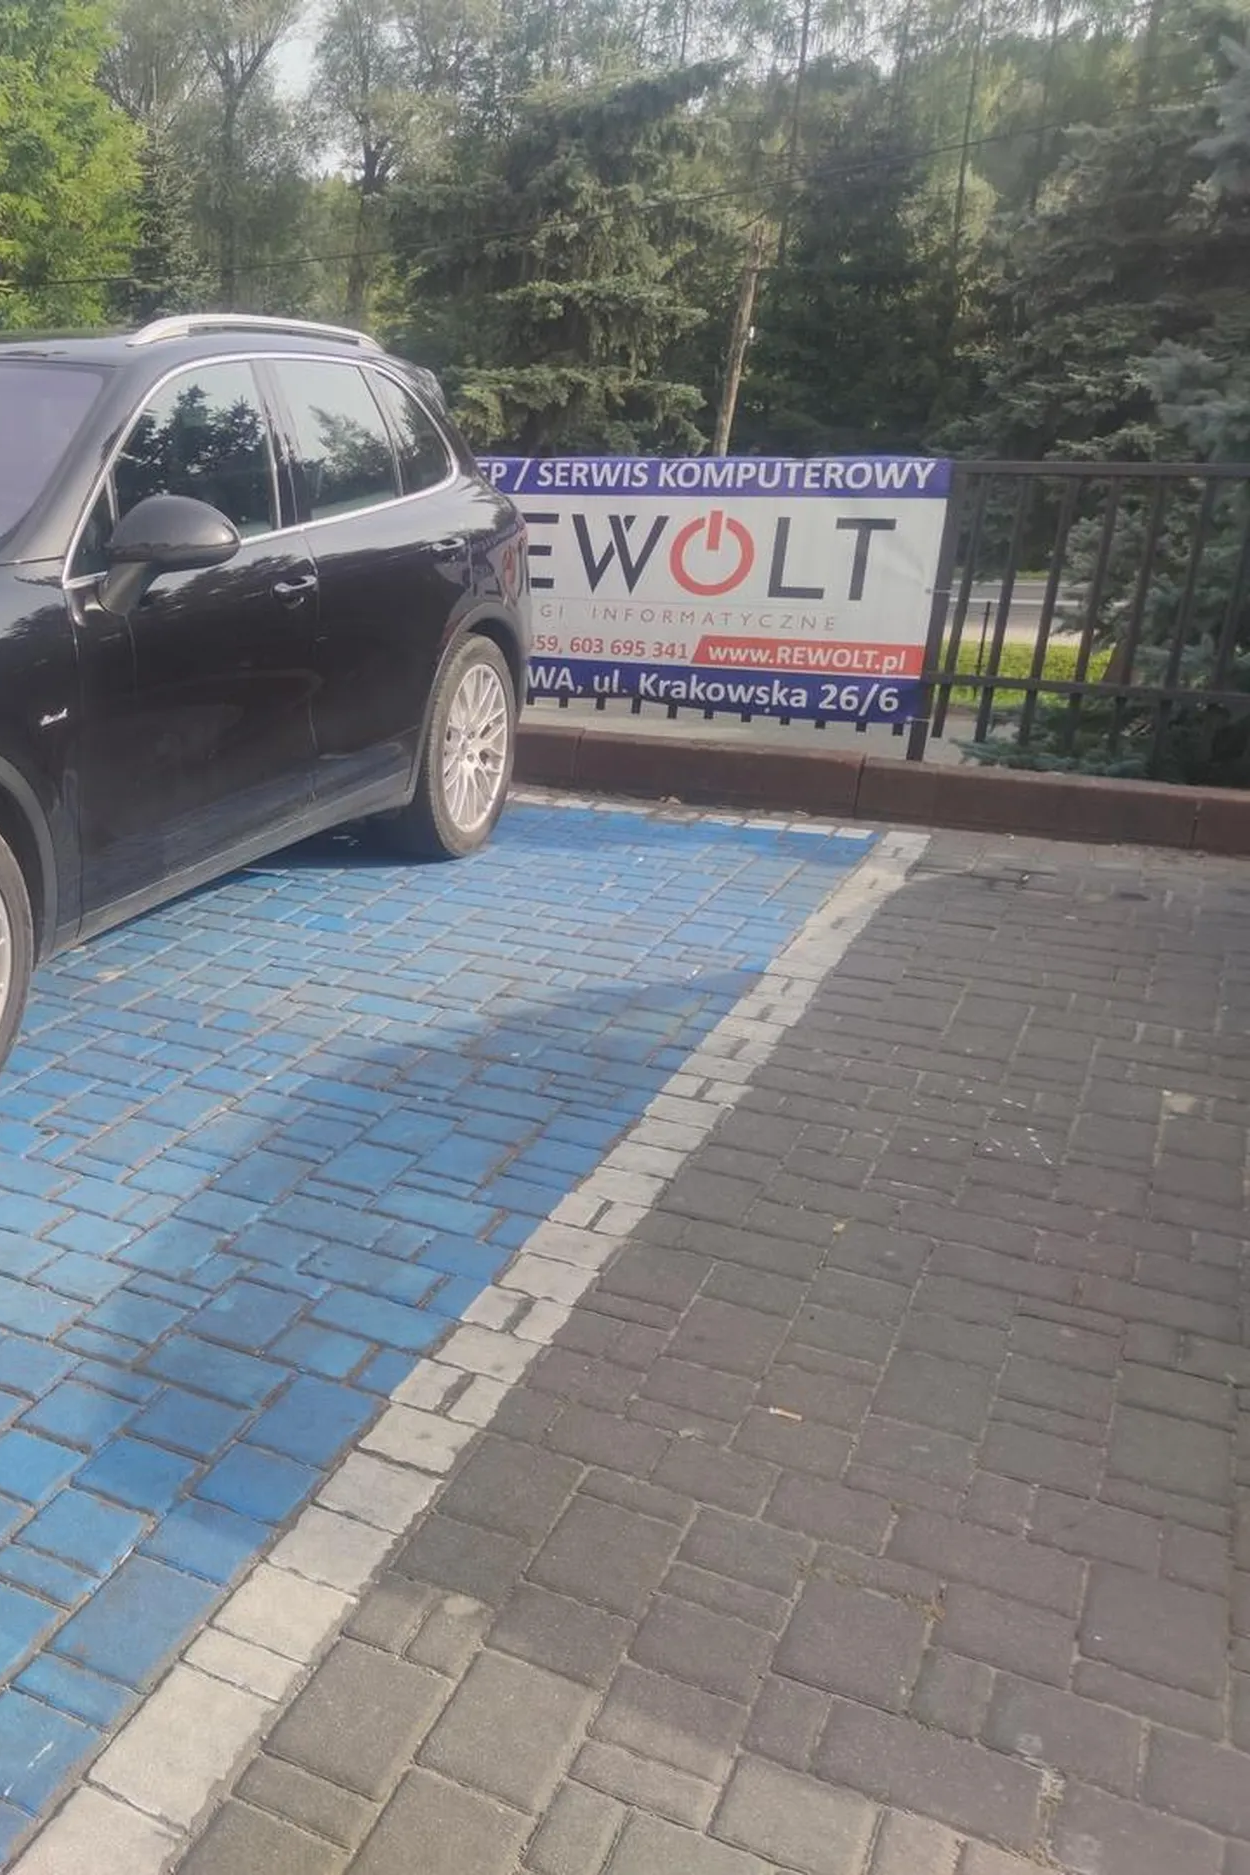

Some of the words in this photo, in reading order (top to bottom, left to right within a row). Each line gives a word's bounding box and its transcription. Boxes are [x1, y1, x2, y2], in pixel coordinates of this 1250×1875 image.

[537, 462, 649, 488] SERWIS
[658, 462, 937, 489] KOMPUTEROWY
[591, 606, 837, 631] INFORMATYCZNE
[570, 637, 604, 654] 603
[611, 639, 646, 657] 695
[653, 642, 688, 659] 341
[708, 644, 906, 674] www.REWOLT.pl
[593, 670, 628, 693] ul.
[639, 672, 808, 708] Krakowska
[818, 683, 899, 716] 26/6
